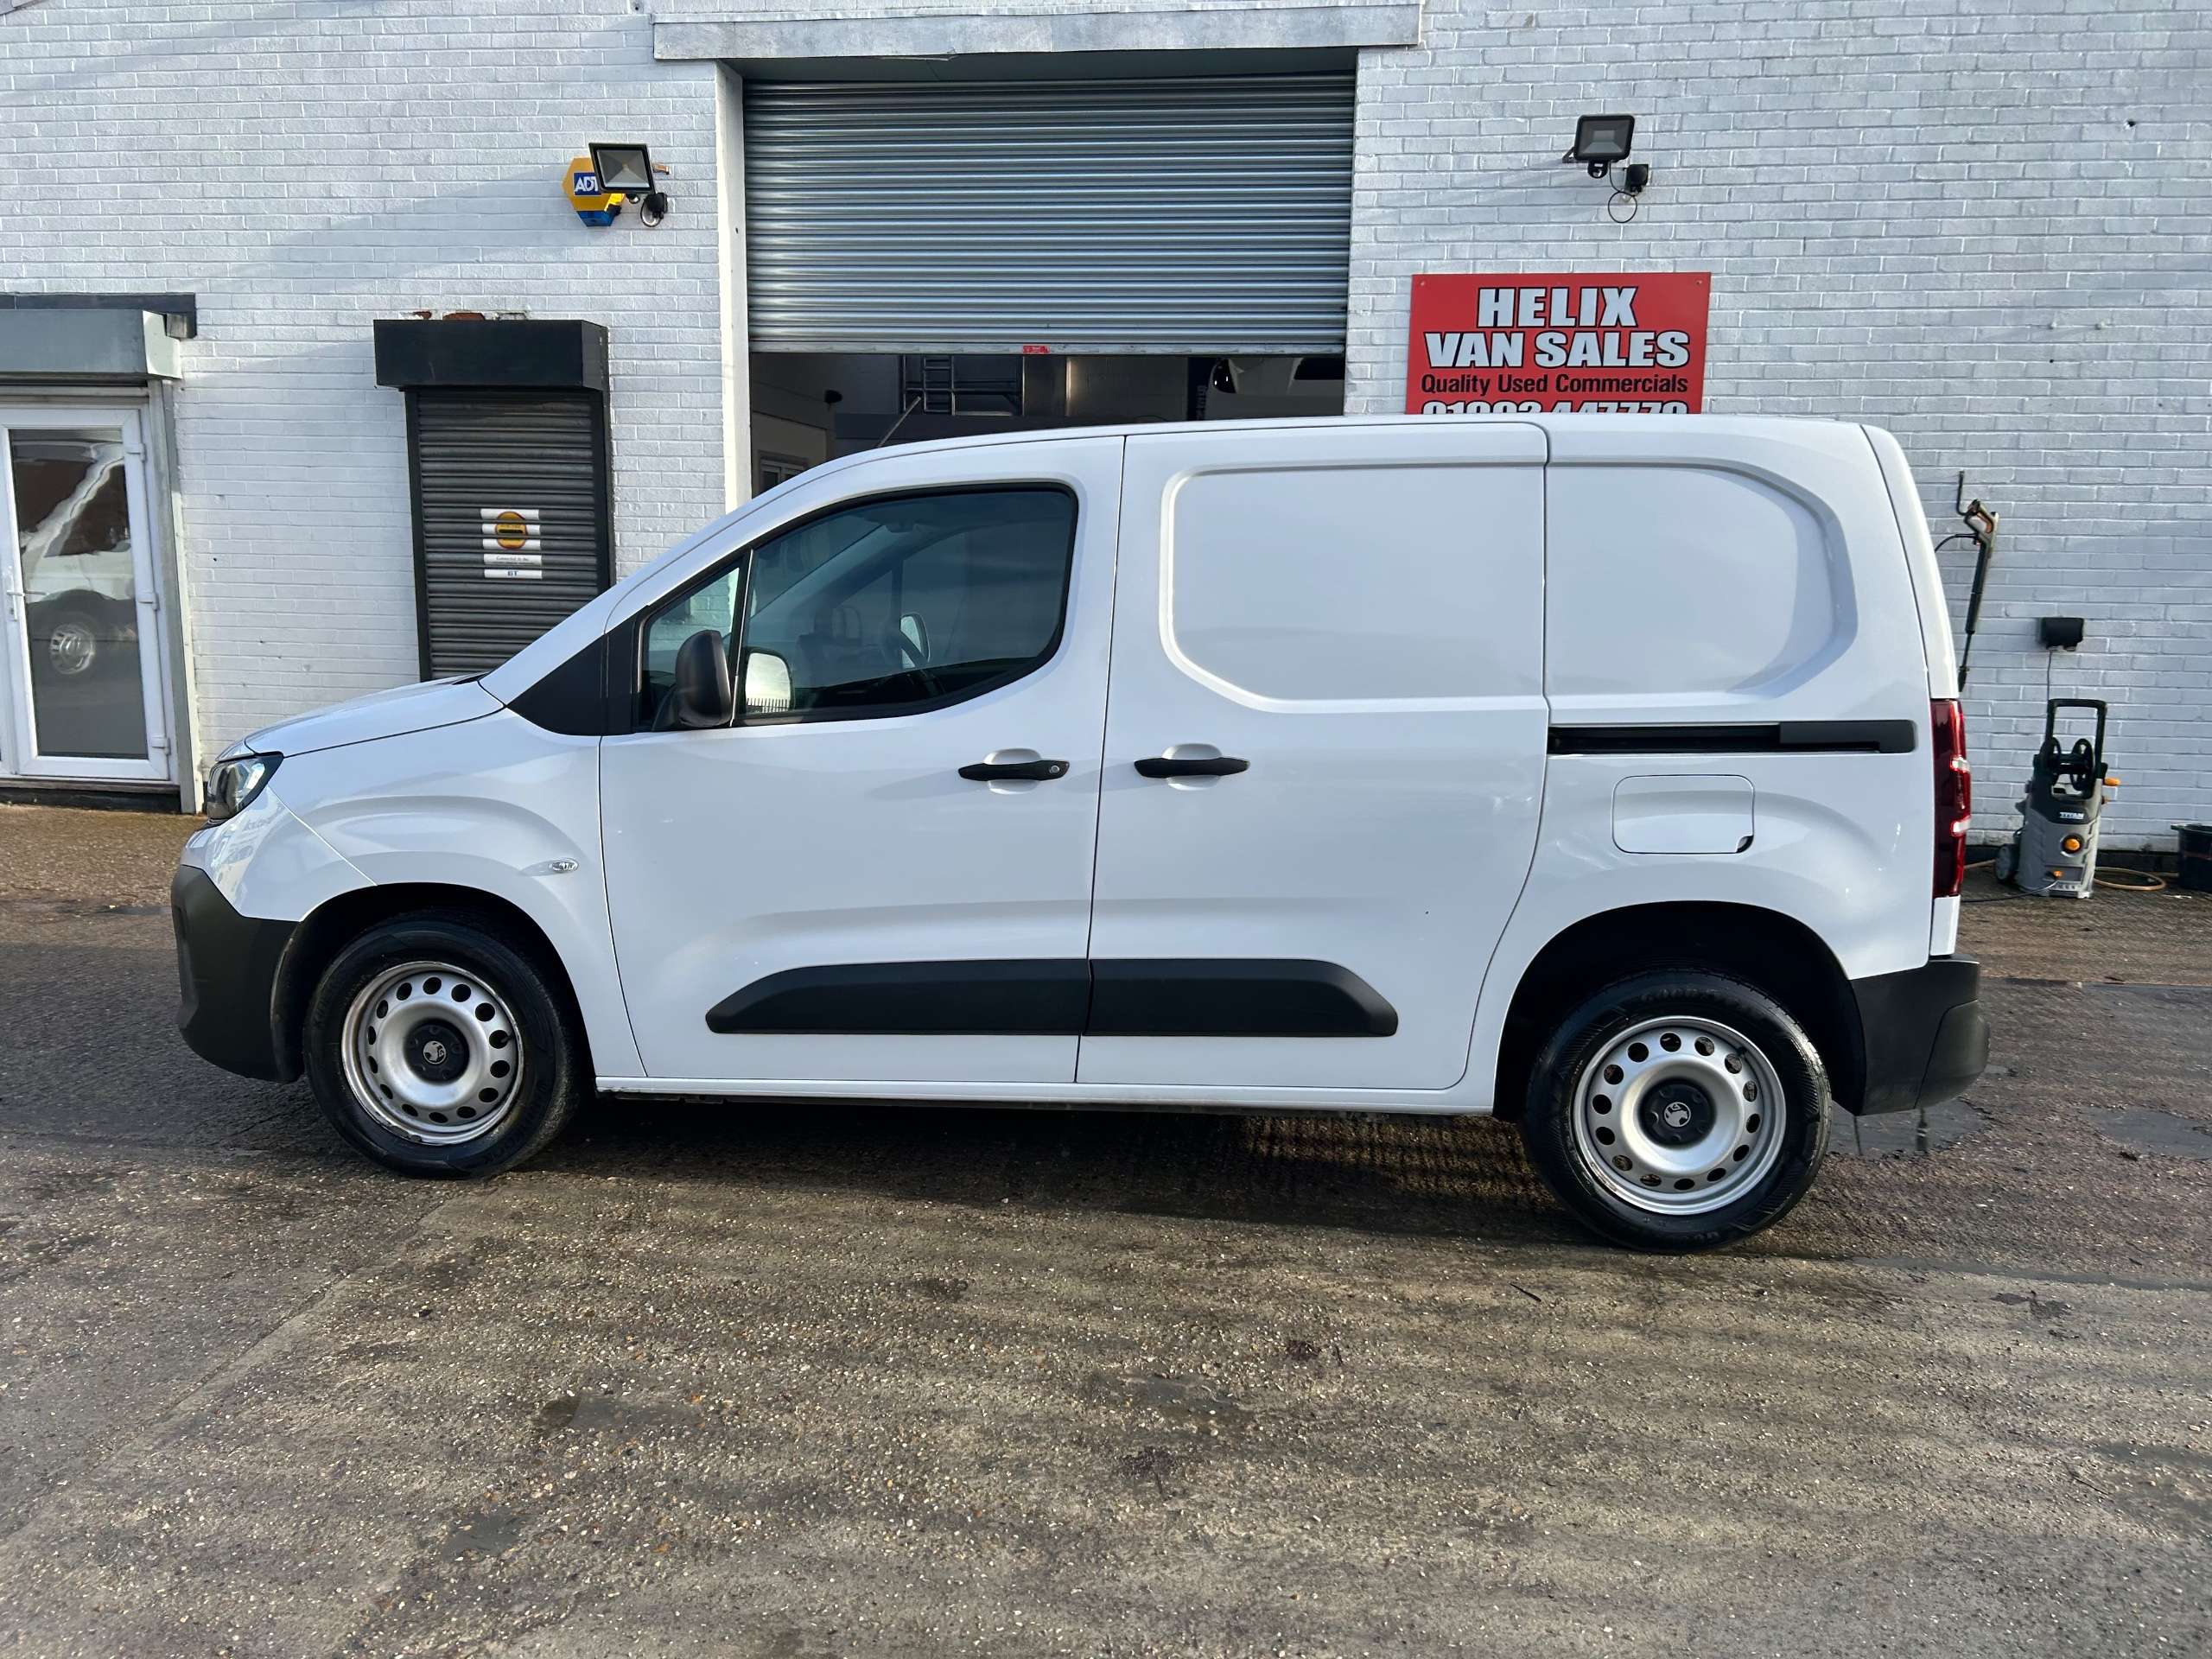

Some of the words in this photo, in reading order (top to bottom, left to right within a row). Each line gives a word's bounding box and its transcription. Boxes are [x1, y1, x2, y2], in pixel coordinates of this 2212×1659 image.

[574, 175, 599, 192] ADT
[1477, 286, 1638, 328] HELIX
[1424, 331, 1525, 368] VAN
[1534, 330, 1690, 368] SALES
[1421, 373, 1491, 397] Quality
[1497, 373, 1548, 393] Used
[1555, 373, 1688, 393] Commercials
